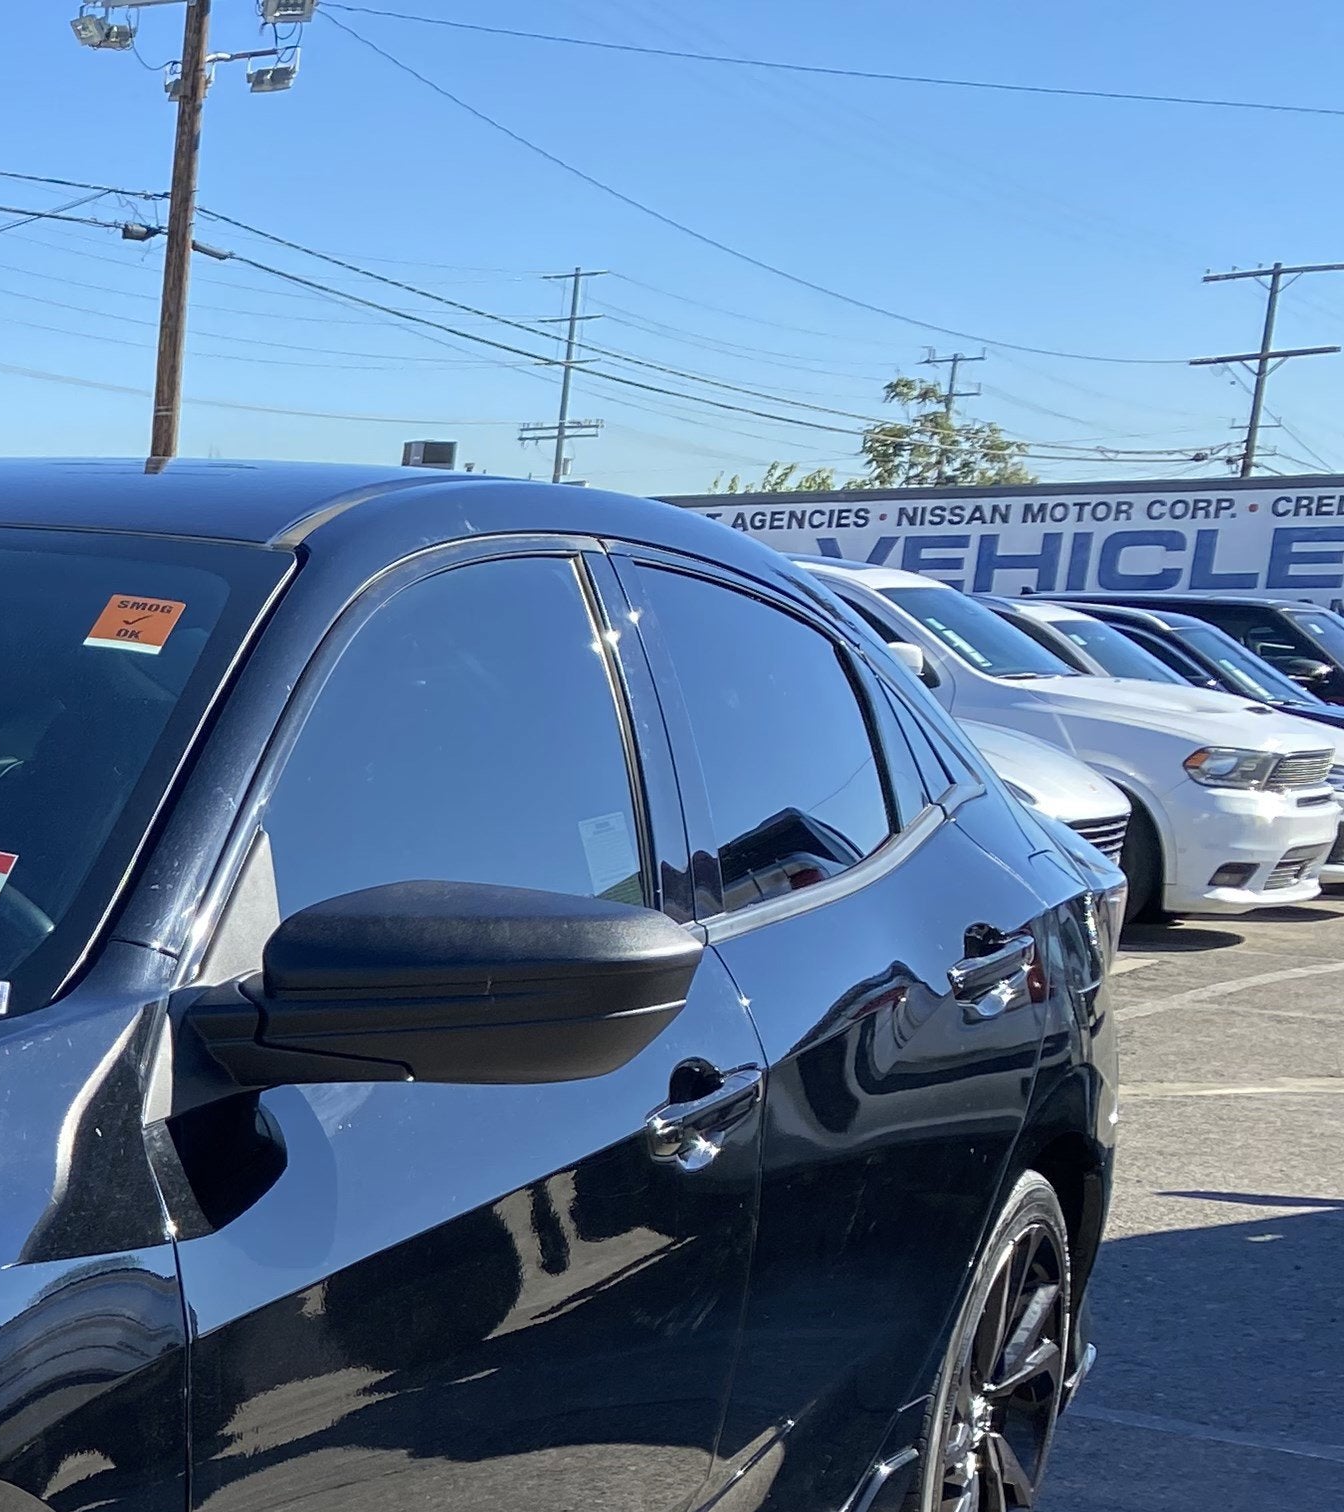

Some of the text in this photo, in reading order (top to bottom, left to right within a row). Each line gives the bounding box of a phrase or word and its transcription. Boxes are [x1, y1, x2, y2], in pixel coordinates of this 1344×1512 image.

[731, 495, 1344, 531] AGENCIES NISSAN MOTOR CORP. CRE
[117, 600, 174, 615] SMOG
[115, 627, 144, 641] OK
